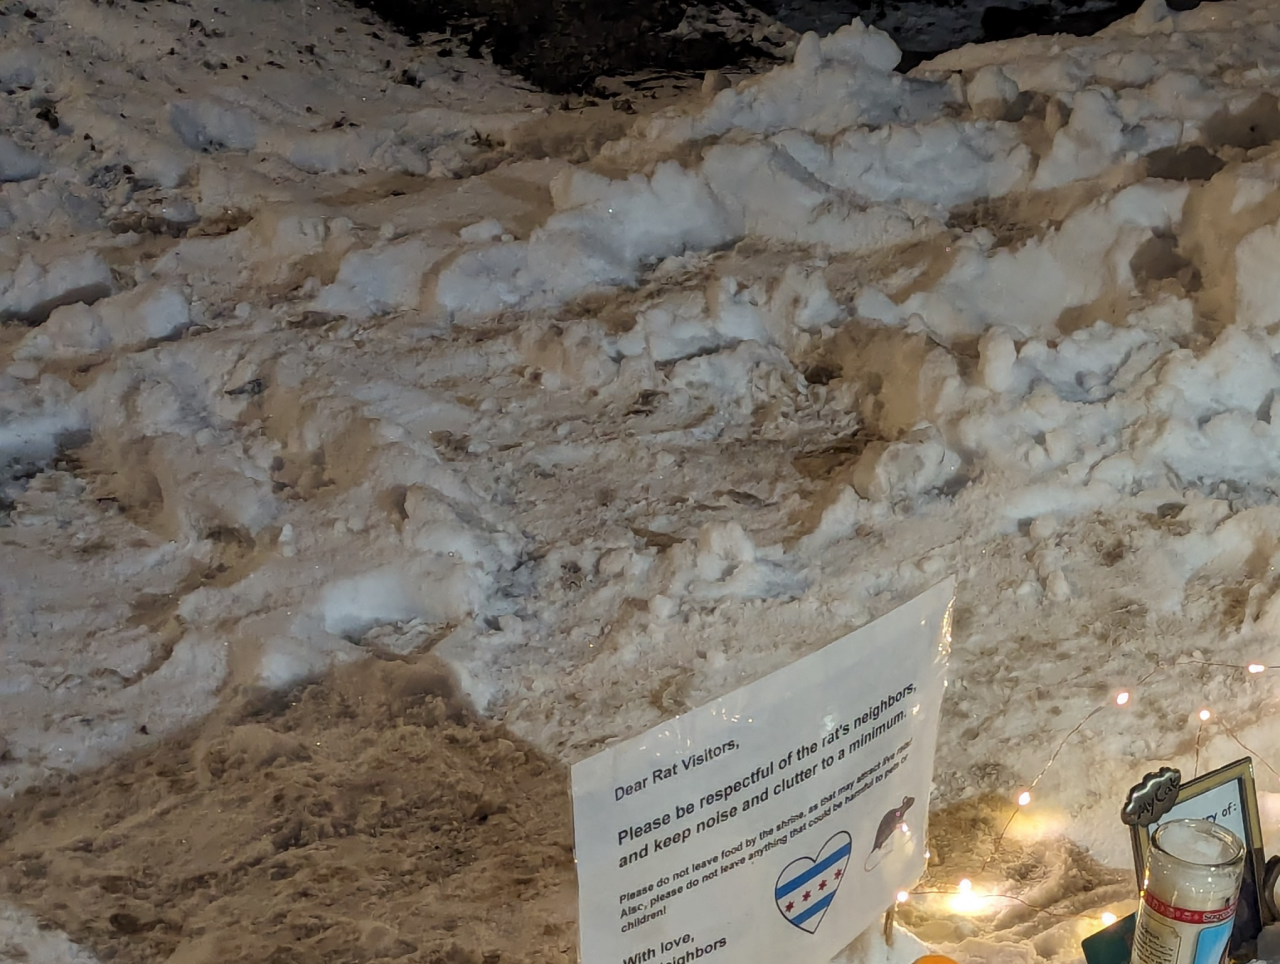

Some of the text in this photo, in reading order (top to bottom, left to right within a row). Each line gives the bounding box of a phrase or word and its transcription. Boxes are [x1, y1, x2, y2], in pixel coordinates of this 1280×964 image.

[614, 739, 740, 801] Dear Rat Visitors,
[618, 683, 917, 845] Please be respectful of the rat's neighbors,
[618, 710, 907, 868] and keep noise and clutter to a minimum.
[1221, 802, 1238, 817] of:
[619, 883, 654, 904] Please
[656, 876, 670, 888] do
[672, 867, 690, 882] not
[692, 855, 719, 873] leave
[721, 842, 743, 860] food
[745, 836, 757, 847] by
[759, 828, 774, 840] the
[808, 803, 819, 814] as
[820, 791, 836, 806] that
[837, 780, 855, 796] may
[650, 886, 684, 908] please
[686, 878, 699, 890] do
[701, 869, 718, 883] not
[720, 857, 746, 874] leave
[748, 835, 788, 860] anything
[789, 823, 807, 838] that
[808, 806, 831, 828] could
[832, 801, 843, 812] be
[875, 774, 884, 784] to
[621, 905, 667, 933] children!
[660, 933, 695, 954] love,
